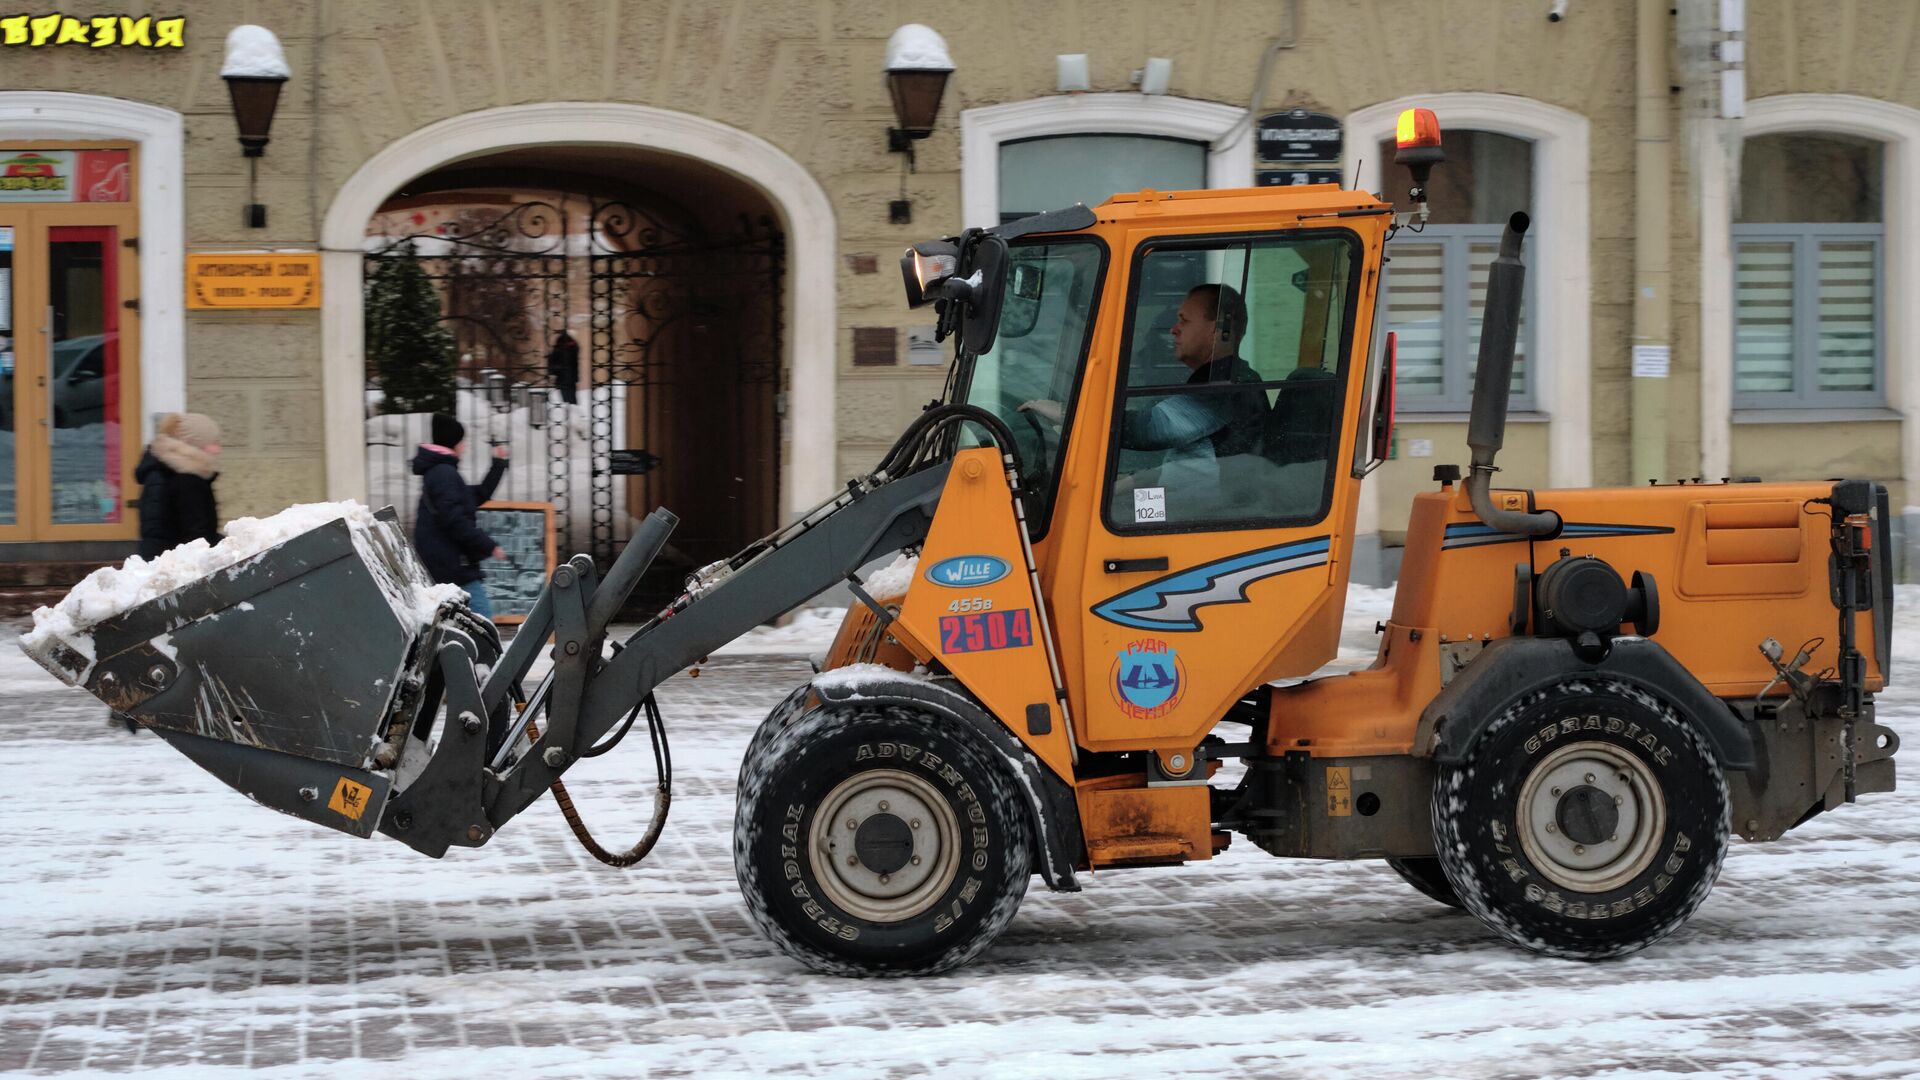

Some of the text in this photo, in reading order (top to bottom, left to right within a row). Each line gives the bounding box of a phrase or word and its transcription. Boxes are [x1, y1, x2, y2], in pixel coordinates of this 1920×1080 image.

[942, 609, 1030, 653] 2504
[1127, 638, 1168, 656] ГУДП
[1120, 696, 1179, 720] ЦЕНТР
[856, 742, 989, 871] ADVENTURO
